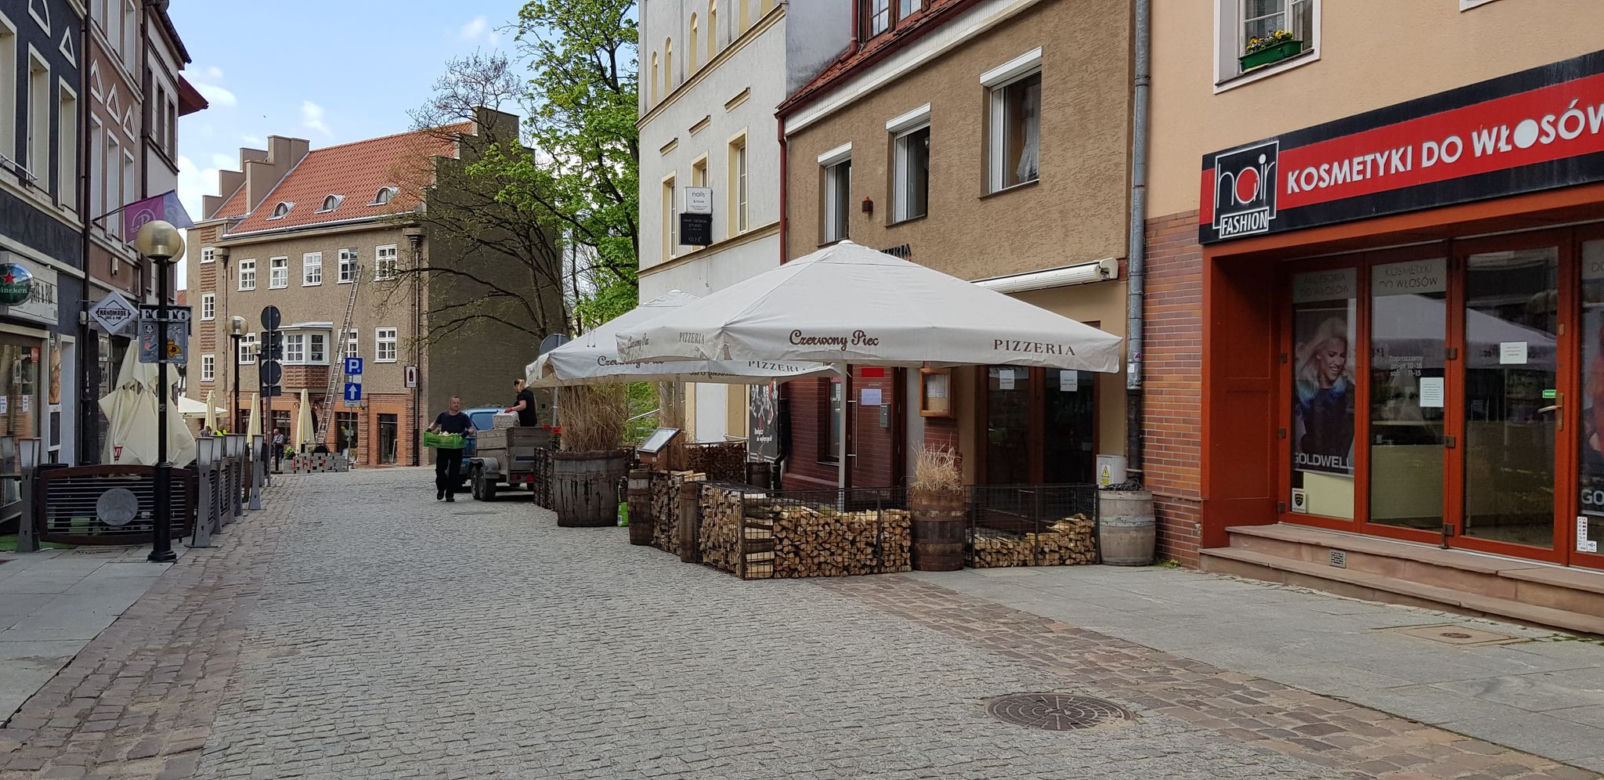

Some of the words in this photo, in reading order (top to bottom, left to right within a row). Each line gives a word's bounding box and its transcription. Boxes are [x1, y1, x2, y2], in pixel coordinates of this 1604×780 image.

[1286, 145, 1413, 195] KOSMETYKI
[1421, 134, 1463, 168] DO
[1216, 153, 1276, 209] hair
[1221, 210, 1268, 236] FASHION
[679, 331, 705, 345] PIZZERIA
[789, 329, 848, 352] Czerwony
[851, 329, 879, 347] Piec
[994, 338, 1075, 357] PIZZERIA
